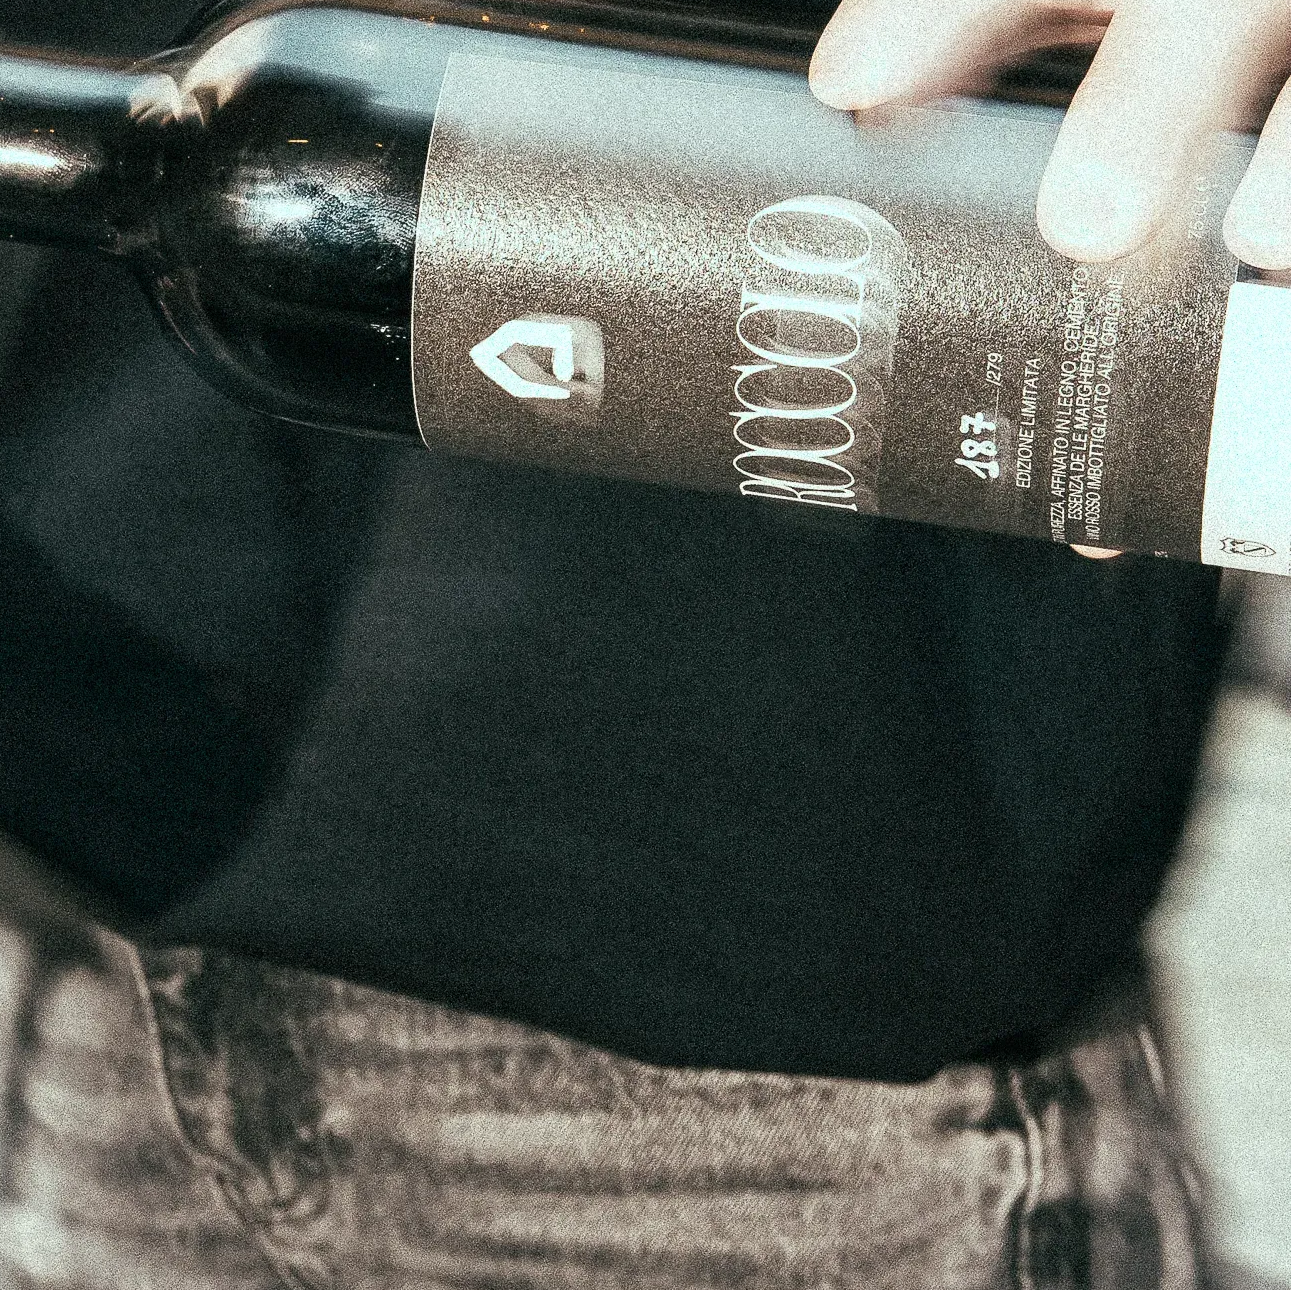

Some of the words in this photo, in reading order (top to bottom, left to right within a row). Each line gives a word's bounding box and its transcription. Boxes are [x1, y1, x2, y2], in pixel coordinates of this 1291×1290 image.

[729, 197, 872, 512] ROCCOLO
[1021, 358, 1042, 426] LIMITATA
[955, 412, 1000, 479] 187
[1055, 418, 1072, 434] IN
[1072, 432, 1088, 451] LE
[1087, 383, 1110, 489] IMBOTTIGLIATO
[1016, 427, 1035, 489] EDIZIONE
[1051, 437, 1069, 498] AFFINATO
[1070, 453, 1086, 472] DE
[1068, 474, 1084, 520] ESSENZA
[1085, 492, 1101, 525] ROSSO
